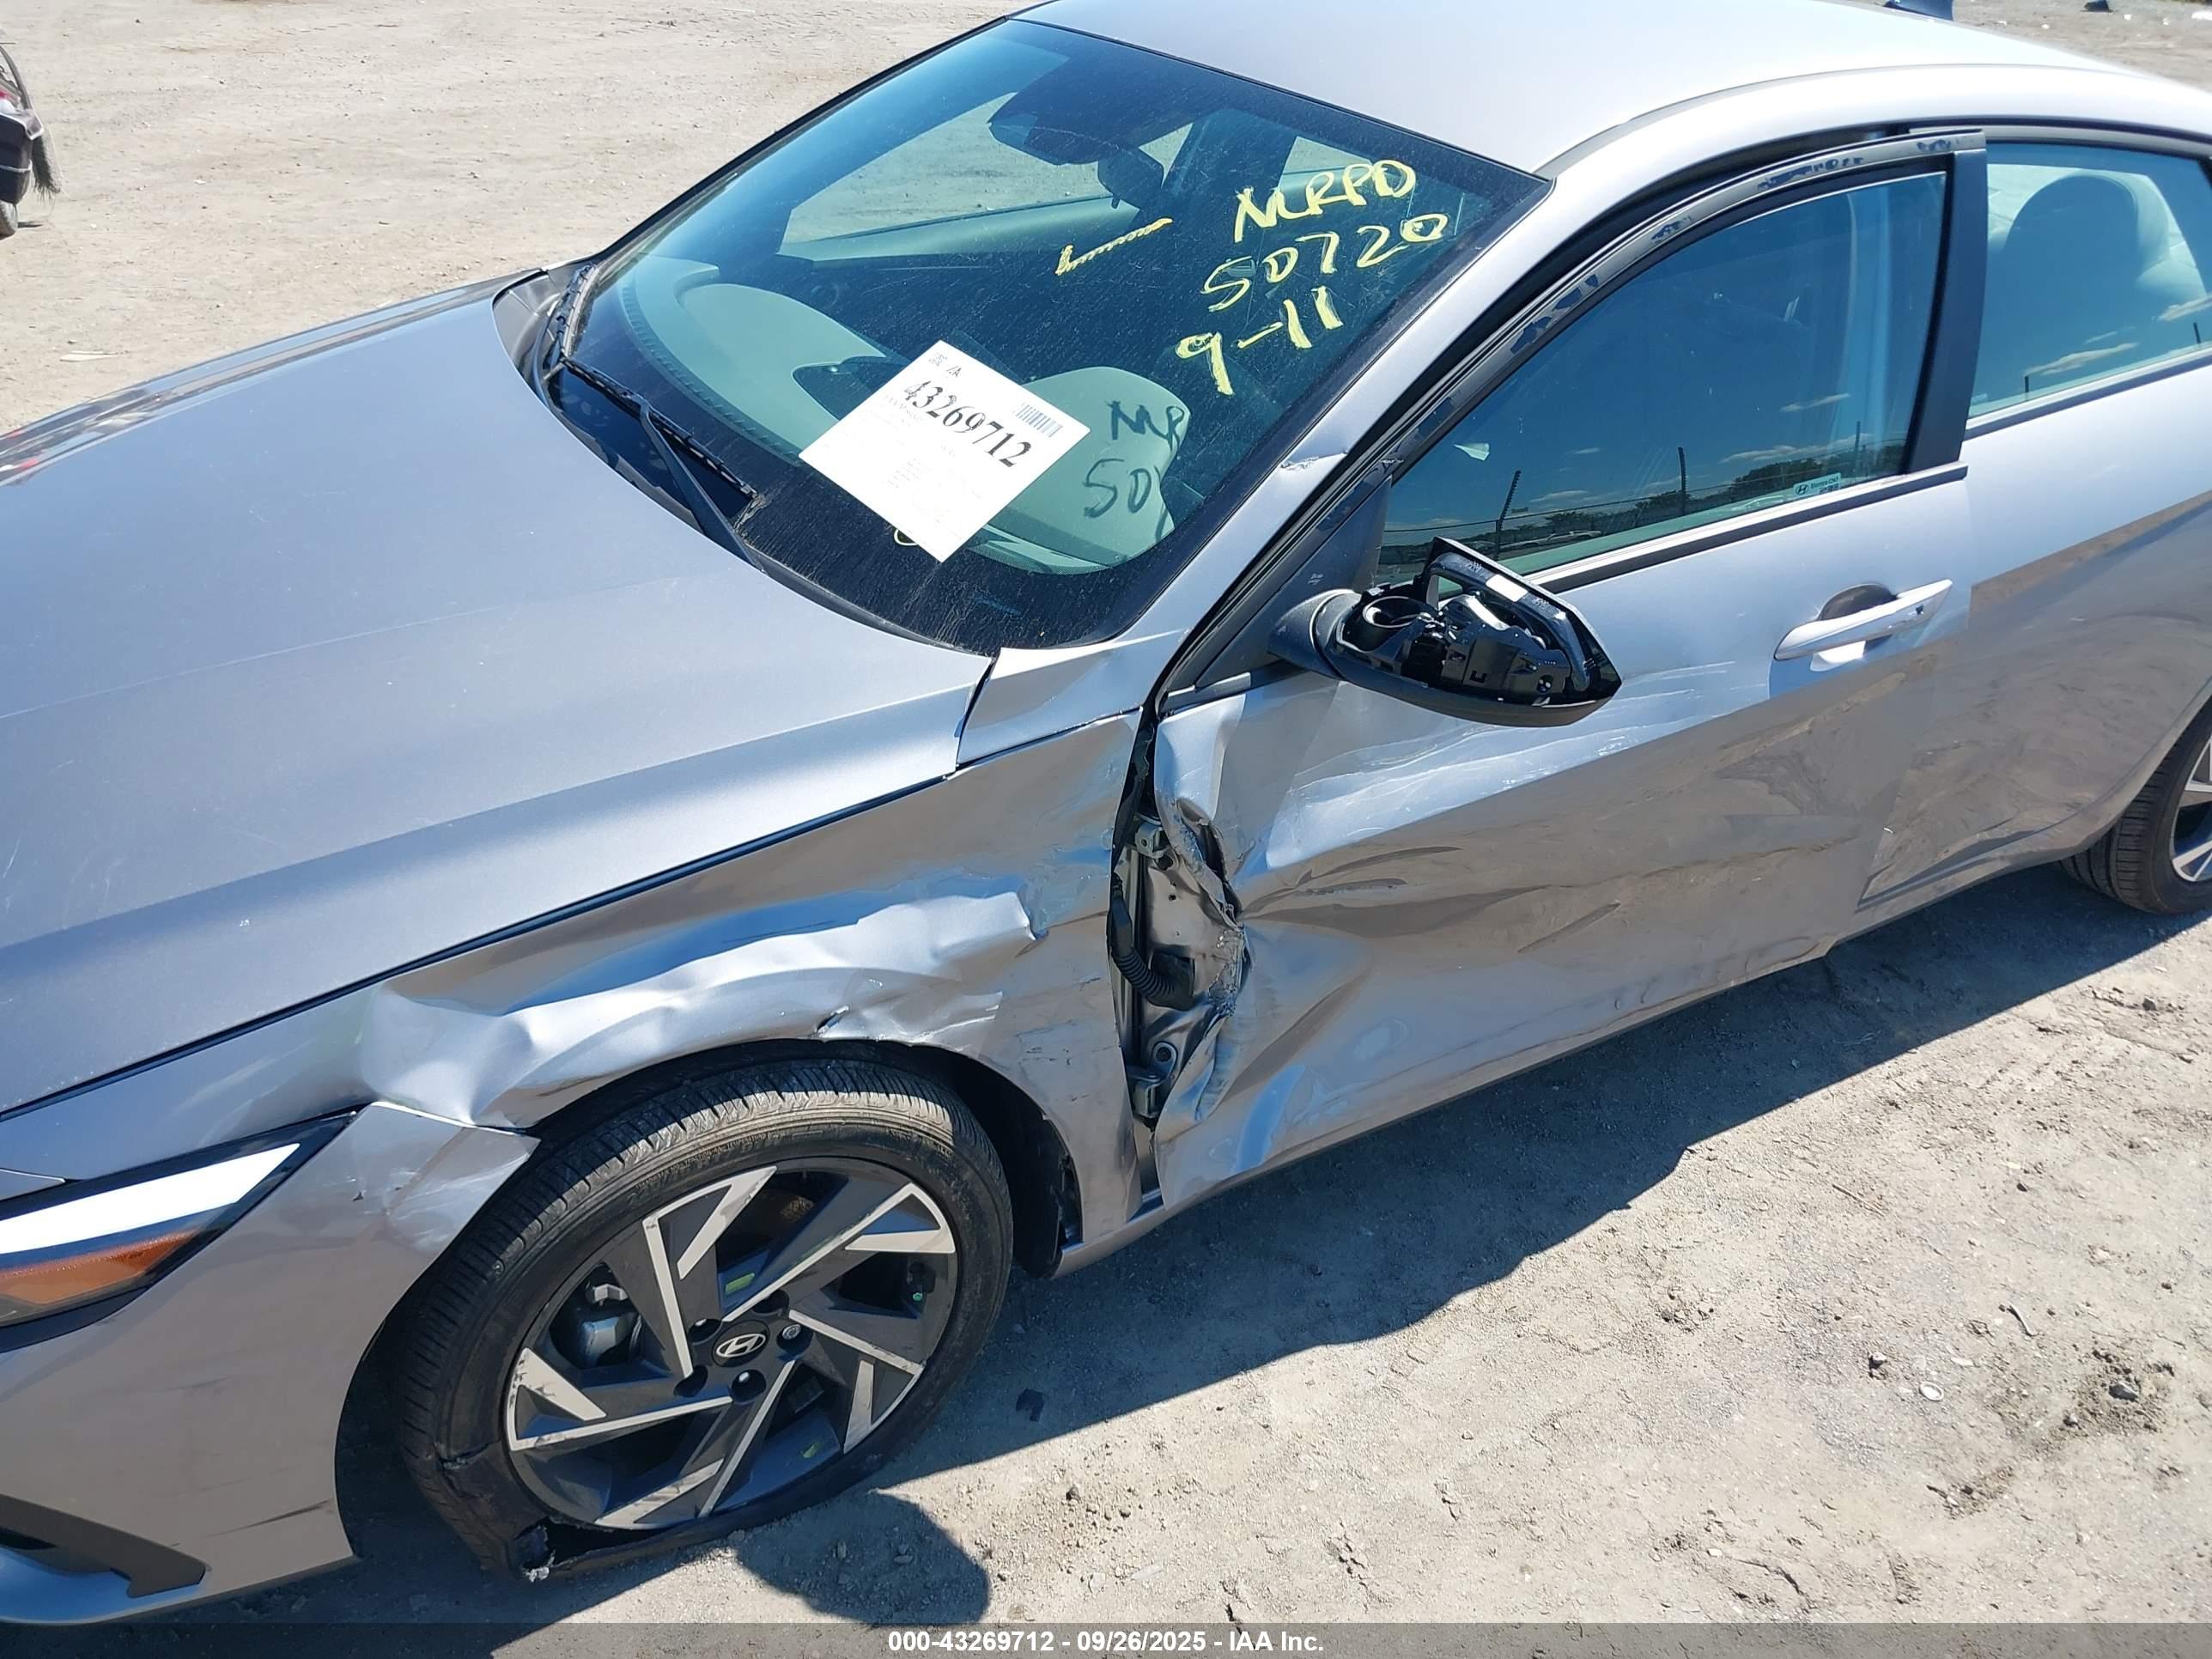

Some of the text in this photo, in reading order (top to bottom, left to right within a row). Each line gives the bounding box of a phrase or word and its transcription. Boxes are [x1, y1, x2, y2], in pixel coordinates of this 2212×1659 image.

[1200, 213, 1449, 312] 50720
[1175, 286, 1343, 396] 9-11
[901, 380, 1031, 469] 43269712
